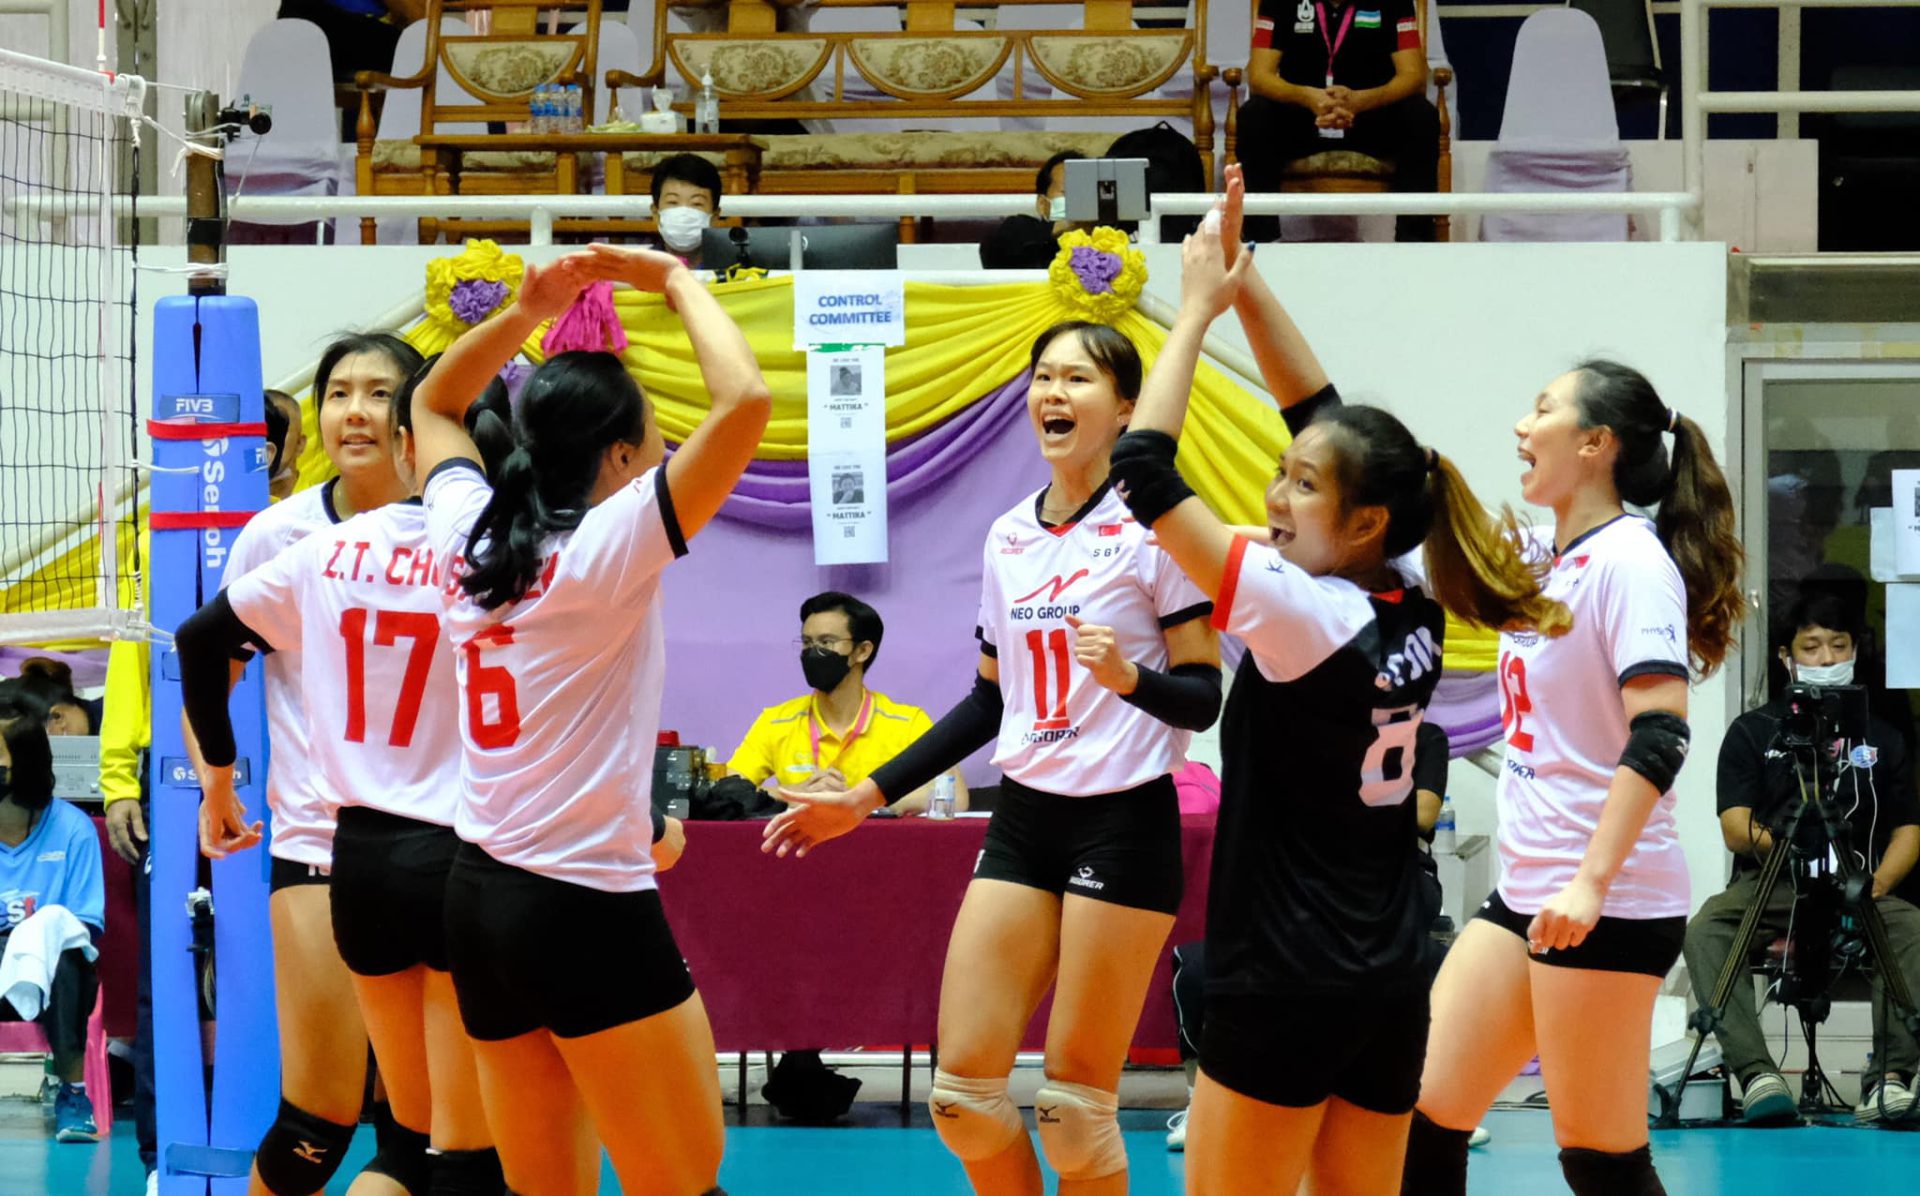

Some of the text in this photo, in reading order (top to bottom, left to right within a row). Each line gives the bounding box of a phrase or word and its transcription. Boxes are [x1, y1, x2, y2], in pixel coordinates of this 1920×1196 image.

[809, 311, 892, 325] COMMITTEE
[818, 293, 882, 307] CONTROL
[1010, 605, 1081, 620] NEO GROUP
[339, 607, 441, 748] 17
[462, 622, 522, 751] 6
[1026, 628, 1071, 731] 11
